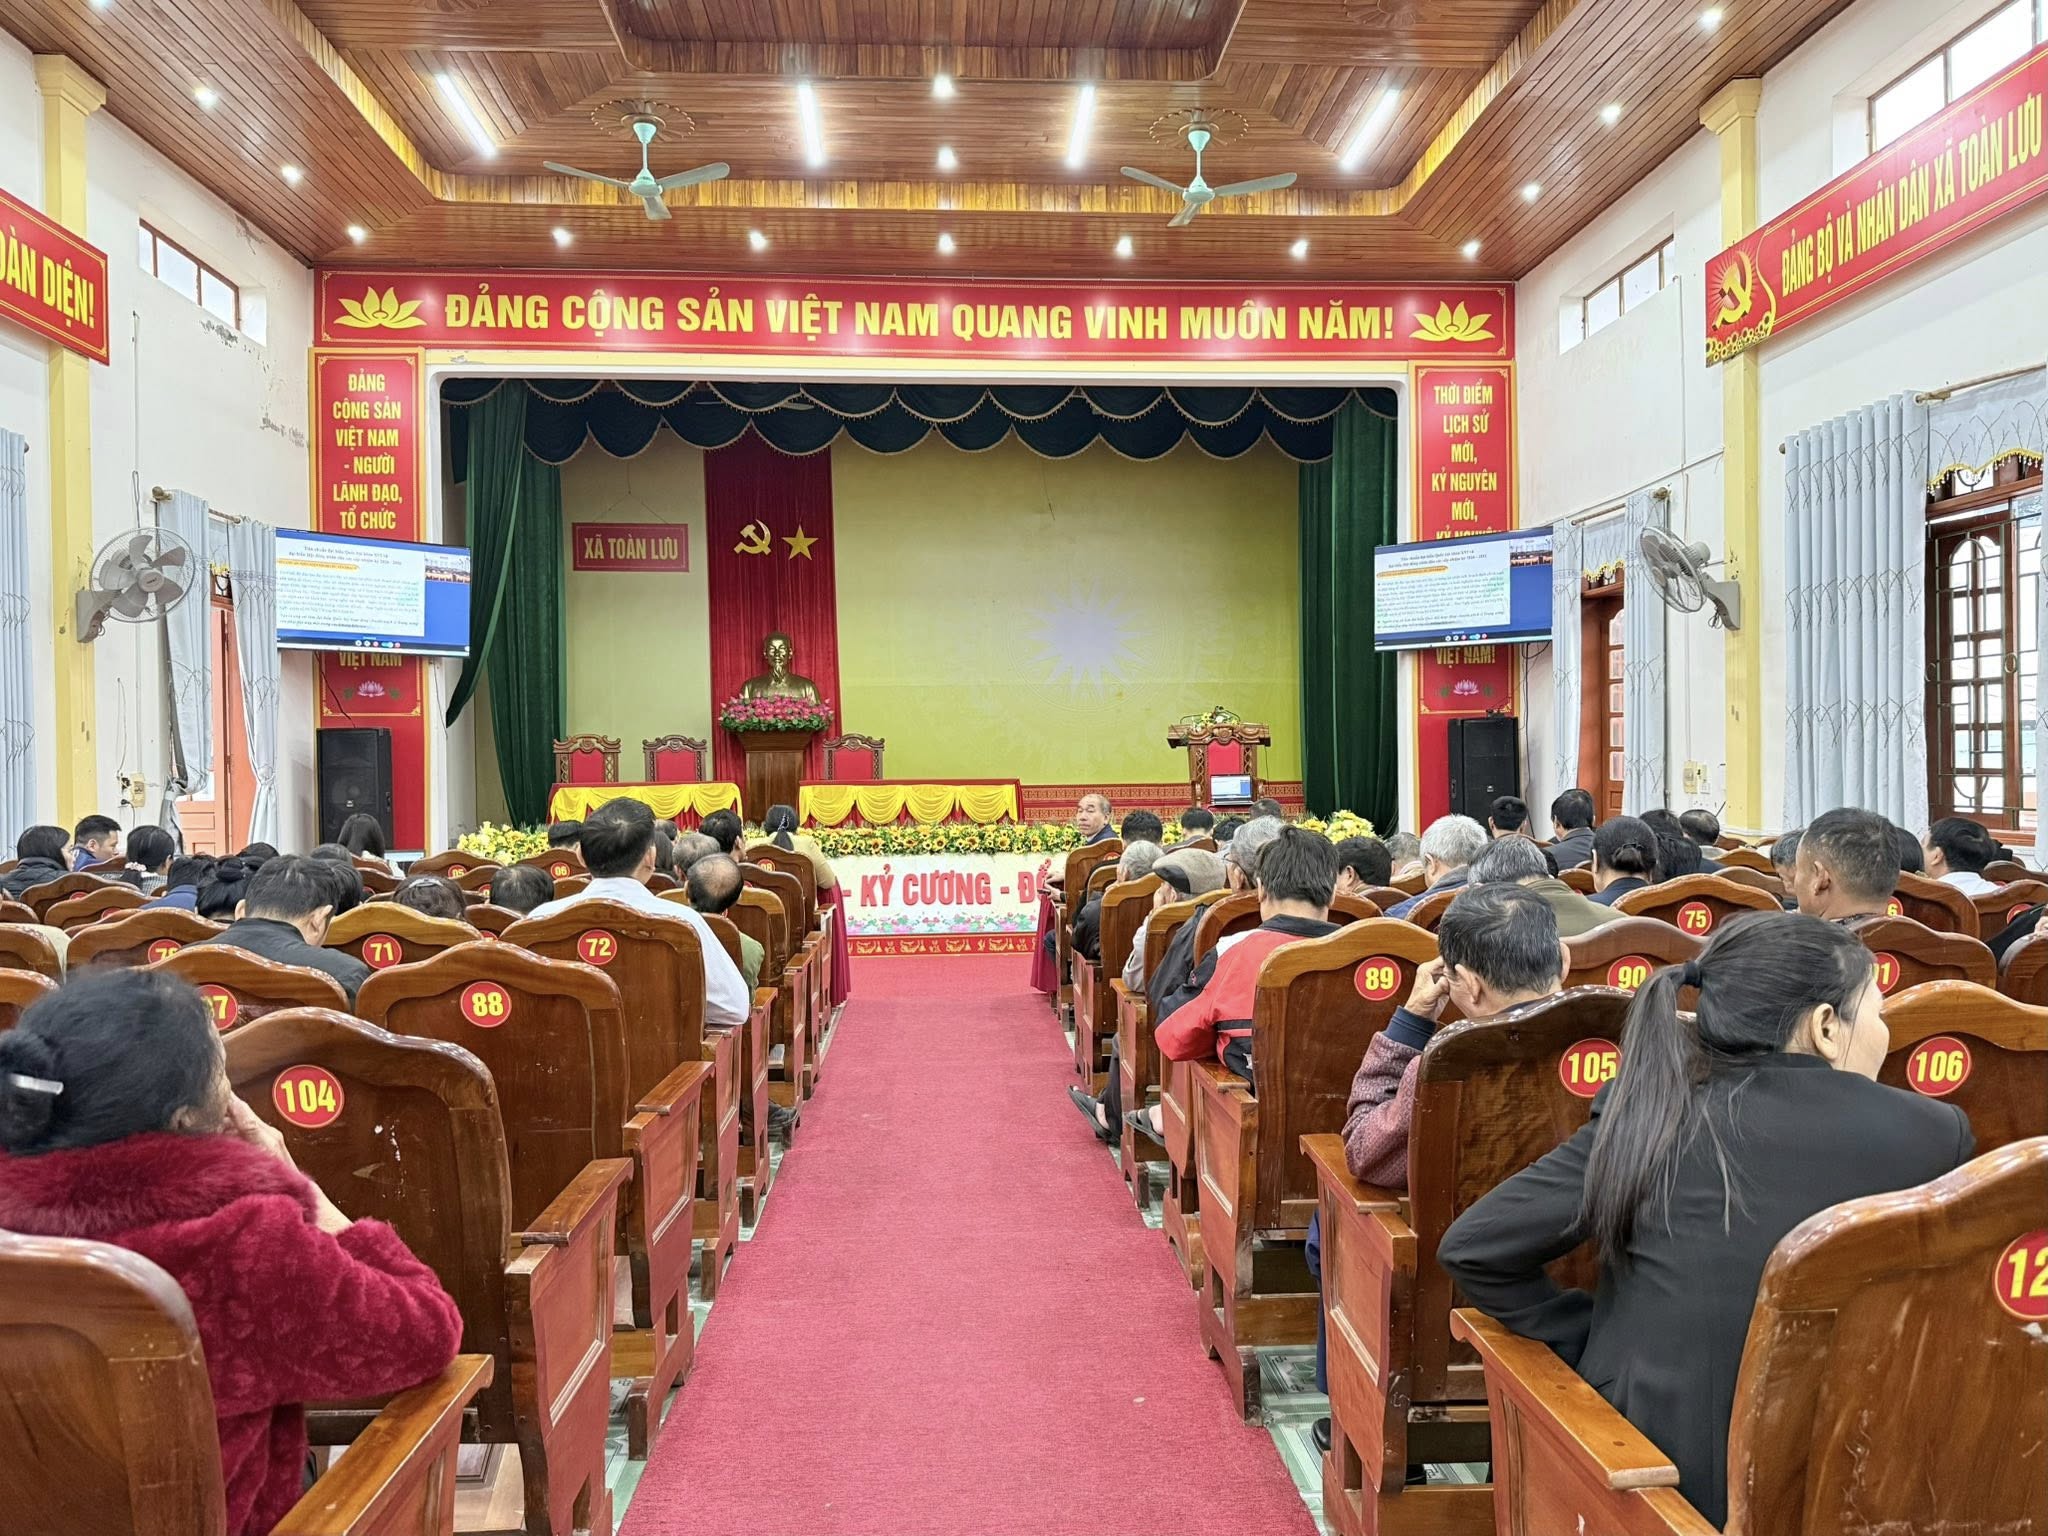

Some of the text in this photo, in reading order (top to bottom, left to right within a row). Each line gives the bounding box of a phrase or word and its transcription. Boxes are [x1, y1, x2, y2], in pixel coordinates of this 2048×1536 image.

[1782, 93, 2042, 297] ĐẢNG BỘ VÀ NHÂN DÂN XÃ TOÀN LƯU
[43, 257, 95, 329] DIỆN!
[444, 283, 1395, 342] ĐẢNG CỘNG SẢN VIỆT NAM QUANG VINH MUÔN NĂM!
[348, 368, 385, 391] ĐẢNG
[1433, 378, 1492, 404] THỜI ĐIỂM
[333, 395, 401, 423] CỘNG SẢN
[1443, 408, 1489, 437] LỊCH SỬ
[335, 425, 399, 450] VIỆT NAM
[353, 452, 395, 474] NGƯỜI
[1451, 440, 1477, 464] MỚI,
[1431, 467, 1497, 491] KỶ NGUYÊN
[333, 480, 402, 506] LÃNH ĐẠO,
[340, 504, 396, 529] TỔ CHỨC
[1451, 498, 1478, 522] MỚI,
[584, 533, 678, 560] XÃ TOÀN LƯU
[371, 652, 402, 667] NAM
[1464, 645, 1495, 664] NAM!
[861, 864, 894, 907] KỶ
[903, 870, 992, 905] CƯƠNG
[1000, 886, 1010, 894] -
[1685, 910, 1706, 929] 75
[370, 943, 395, 962] 71
[585, 938, 612, 957] 72
[1365, 966, 1394, 990] 89
[1618, 965, 1648, 989] 90
[471, 991, 504, 1018] 88
[1568, 1051, 1617, 1084] 105
[1916, 1050, 1964, 1083] 106
[281, 1079, 337, 1113] 104
